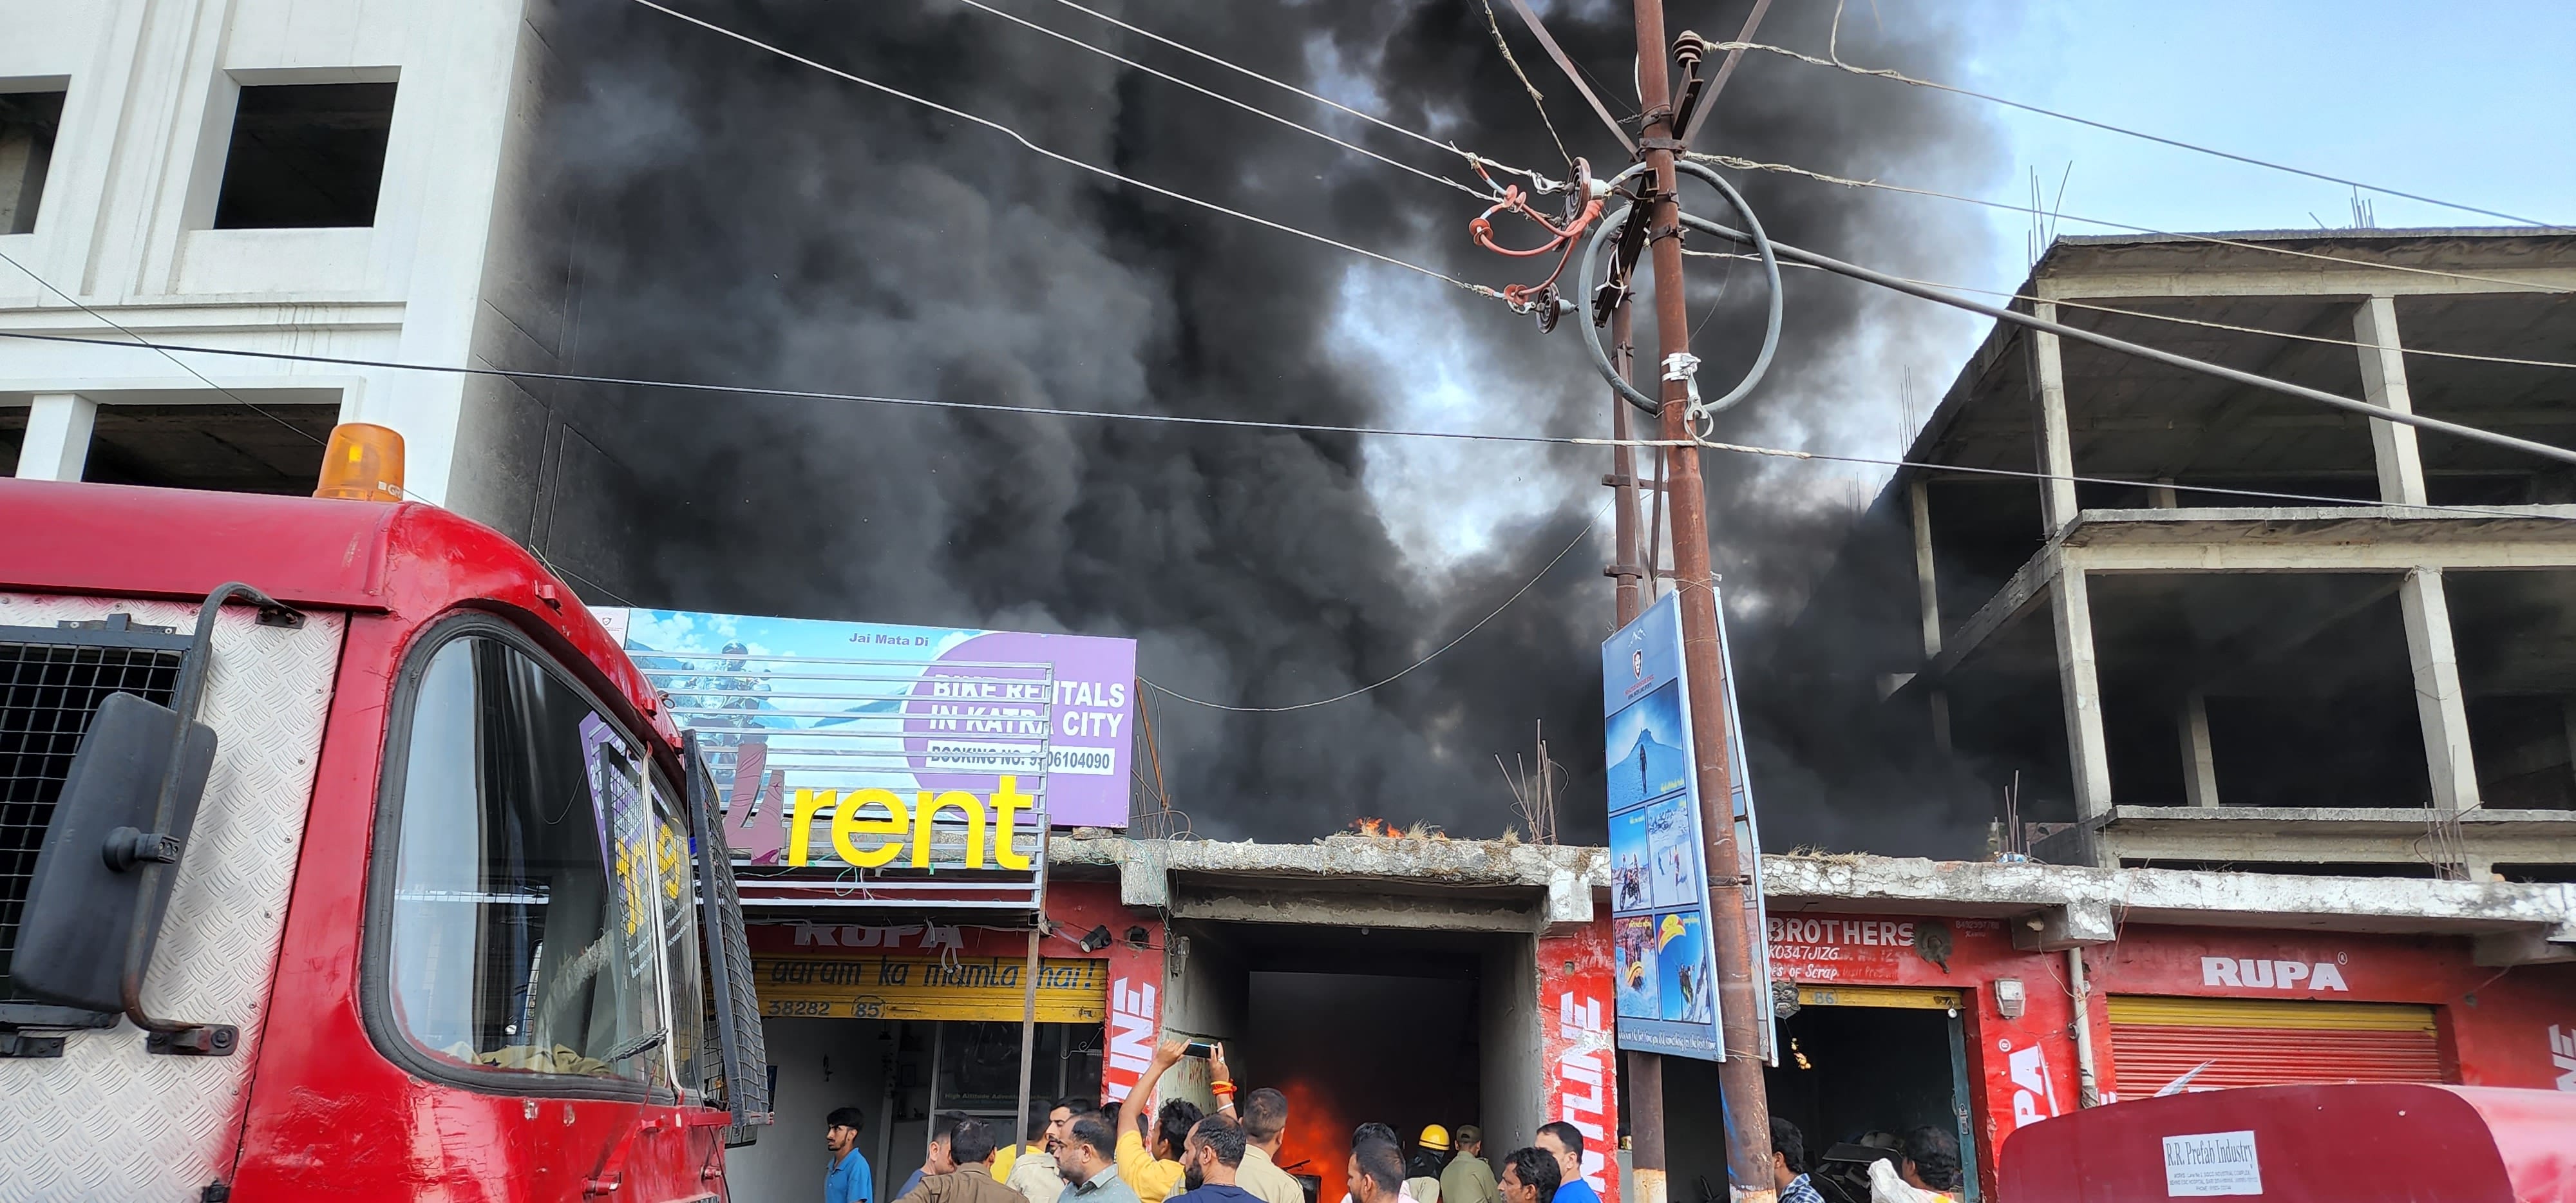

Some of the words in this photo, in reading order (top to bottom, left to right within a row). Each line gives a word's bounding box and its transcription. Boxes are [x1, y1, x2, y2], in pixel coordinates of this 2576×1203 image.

[849, 632, 871, 643] Jai
[875, 634, 909, 645] Mata
[914, 636, 929, 647] Di
[933, 674, 998, 700] BIKE
[929, 705, 958, 731] IN
[1063, 711, 1124, 738] CITY
[931, 746, 997, 765] BOOKING
[1029, 750, 1110, 770] 906104090
[1767, 917, 1915, 947] BROTHERS
[878, 954, 909, 986] ka
[923, 957, 1019, 988] mamla
[2201, 956, 2349, 992] RUPA
[855, 1002, 880, 1018] 85
[2166, 1142, 2185, 1166] R.R.
[2185, 1139, 2215, 1165] Prefab
[2215, 1139, 2253, 1170] Industry
